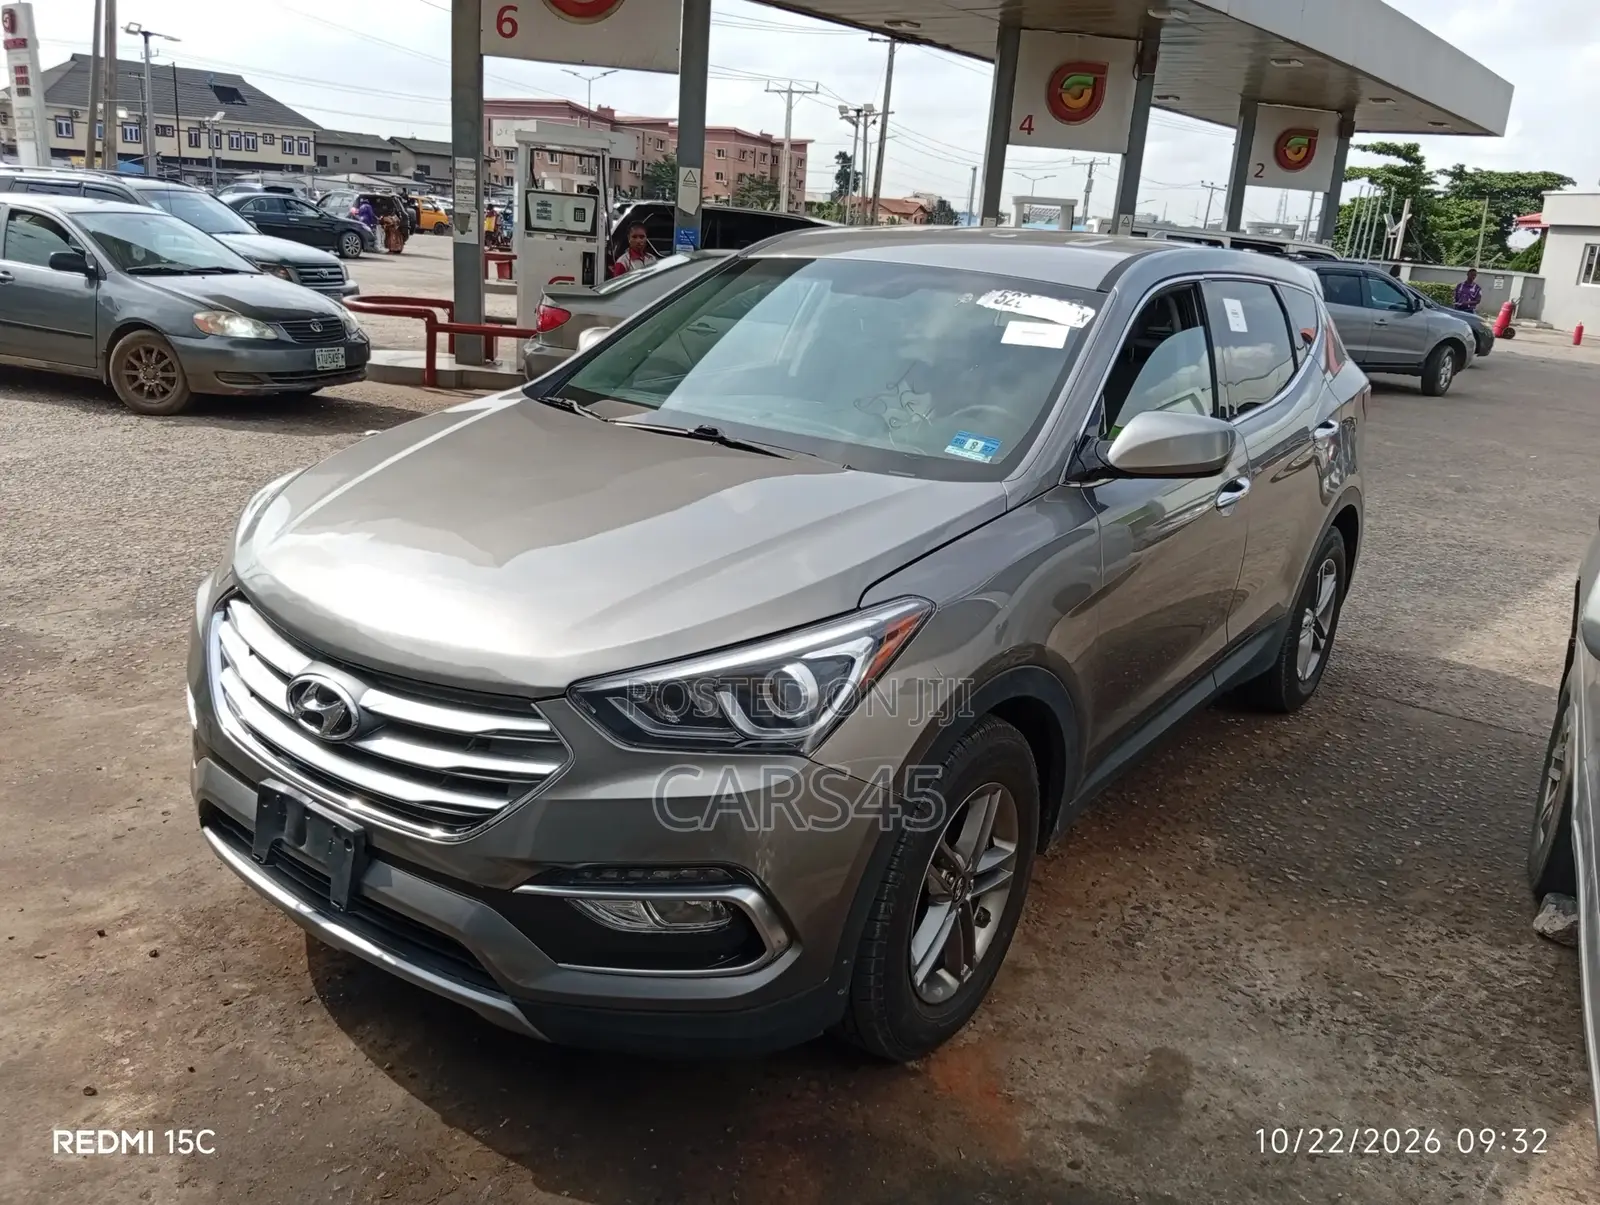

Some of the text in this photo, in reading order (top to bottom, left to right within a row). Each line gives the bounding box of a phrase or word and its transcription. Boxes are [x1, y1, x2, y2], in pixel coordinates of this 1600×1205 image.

[496, 5, 518, 39] 6
[1019, 115, 1034, 135] 4
[1254, 163, 1265, 178] 2
